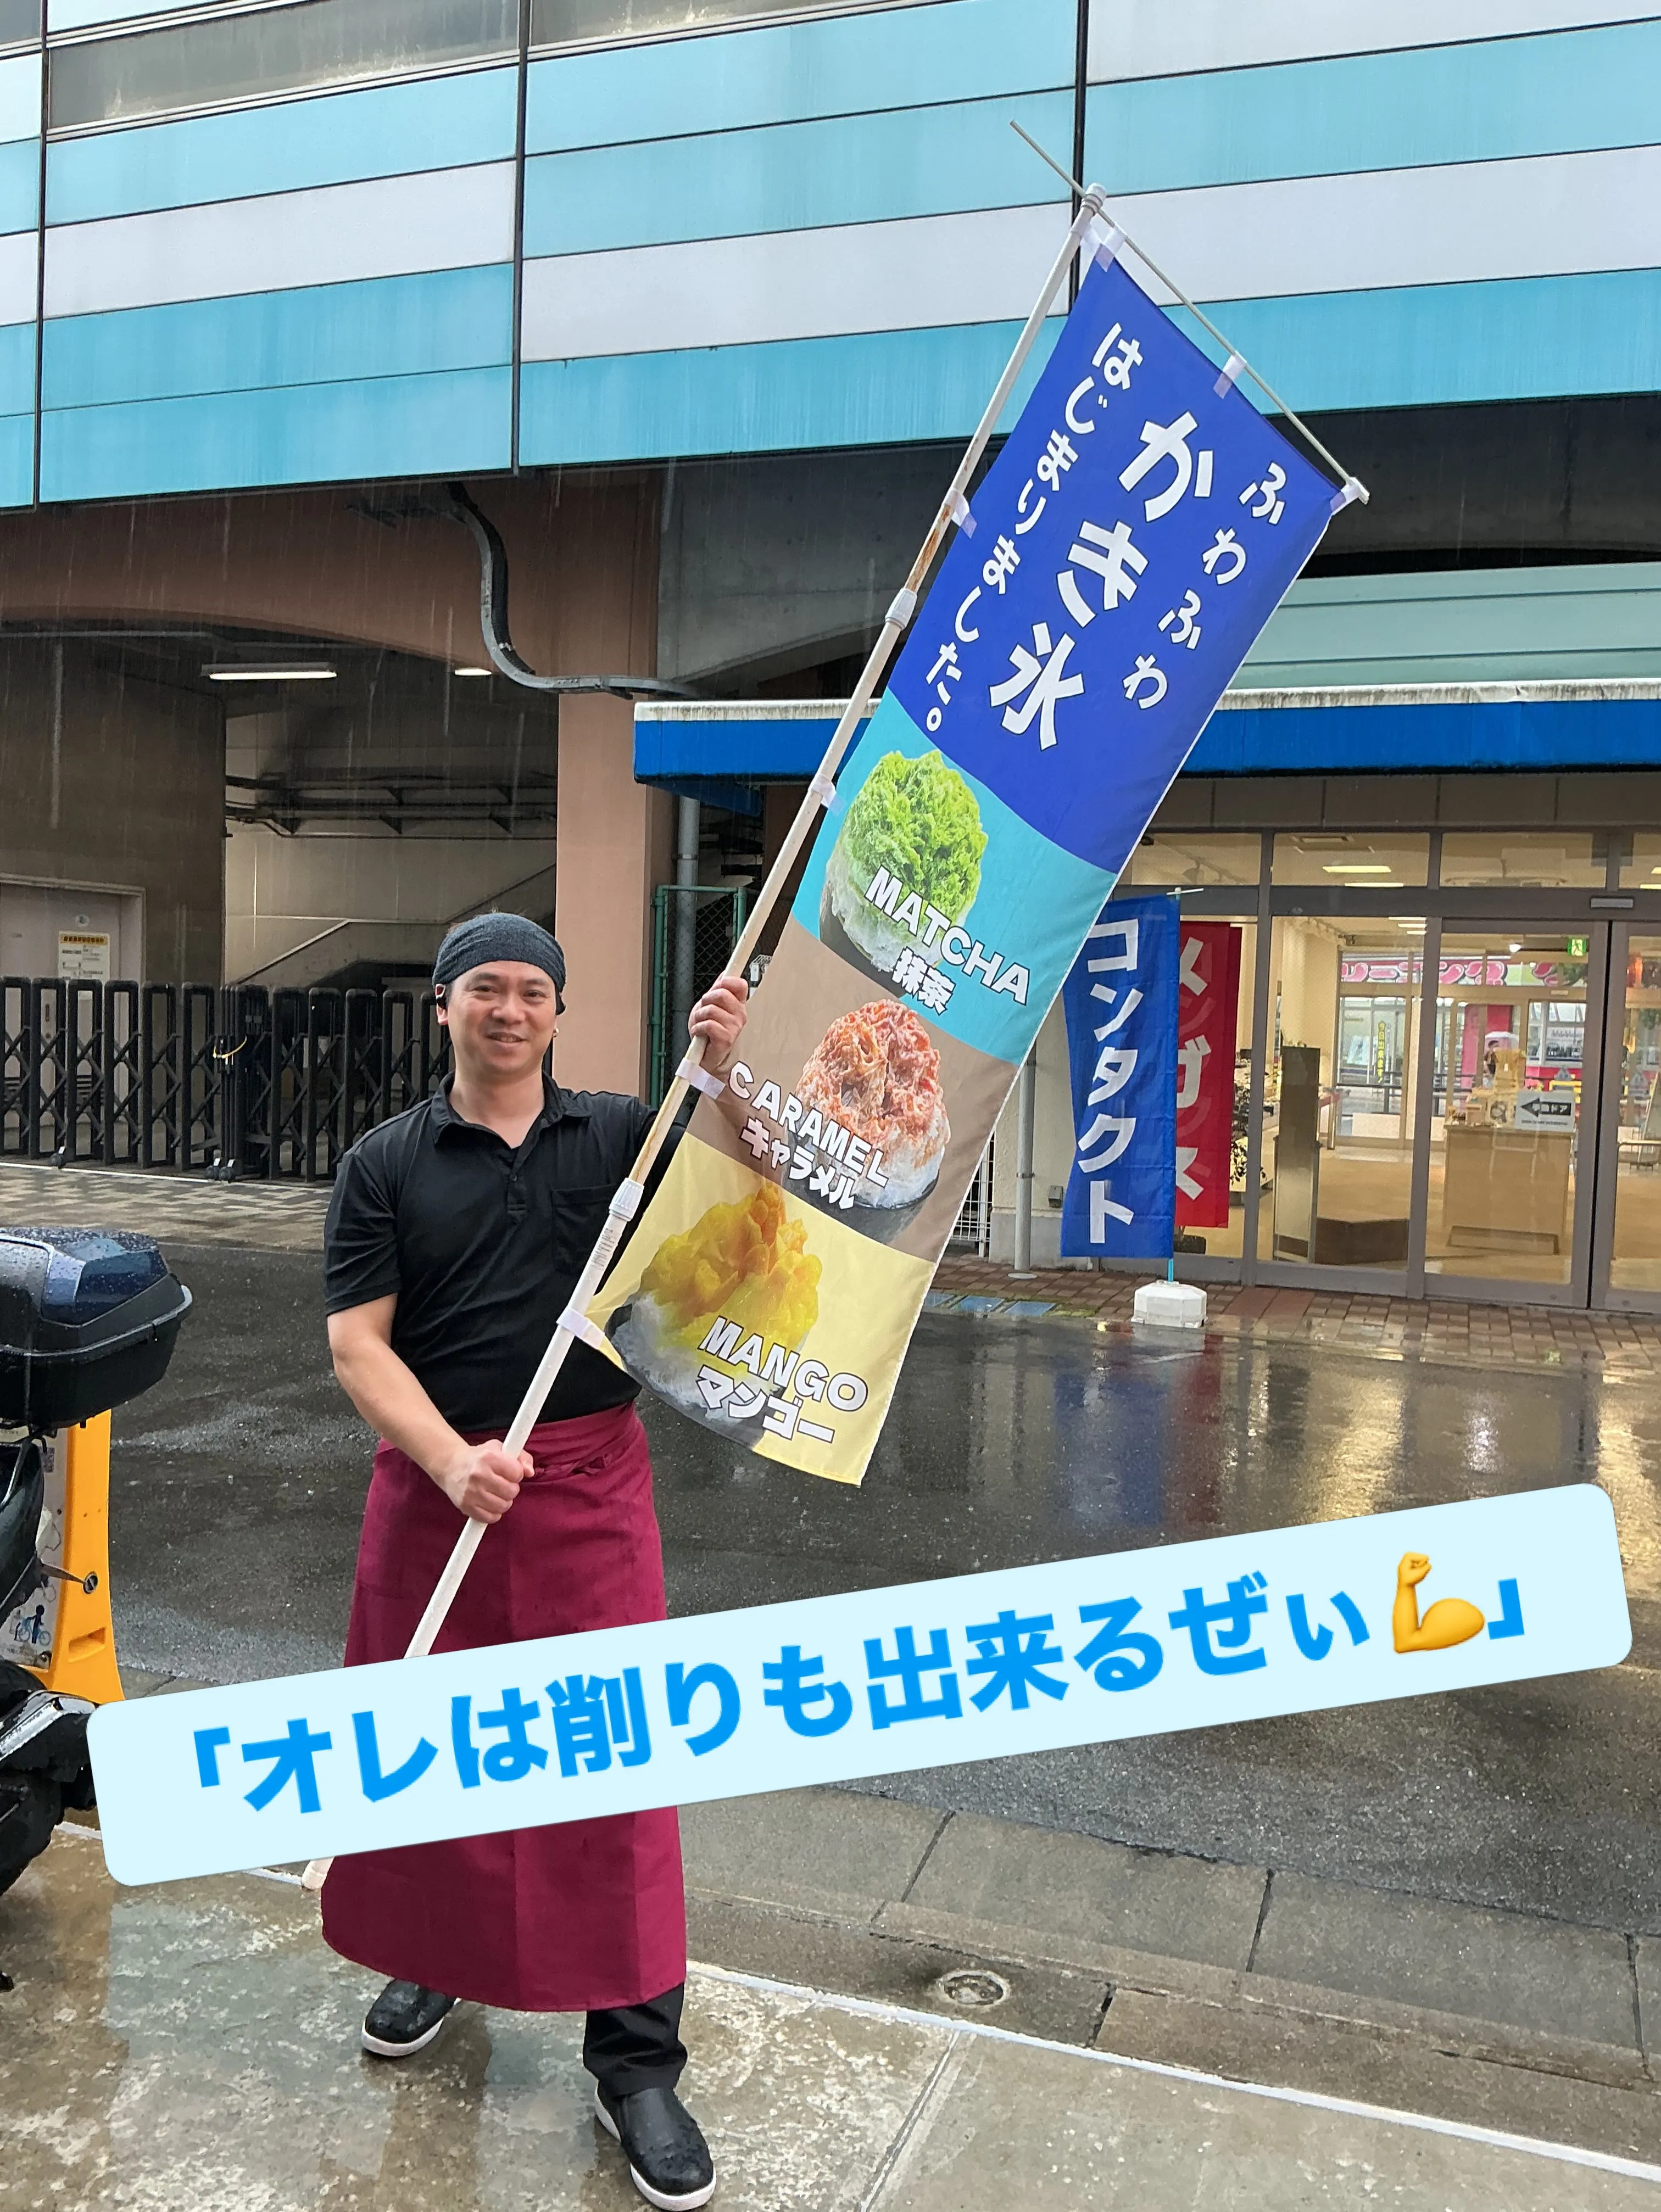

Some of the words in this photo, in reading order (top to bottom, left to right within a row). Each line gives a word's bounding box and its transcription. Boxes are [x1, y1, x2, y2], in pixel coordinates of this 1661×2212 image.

[926, 322, 1143, 731] はじまりました。
[989, 411, 1213, 750] かき氷
[1123, 462, 1286, 709] ふわふわ
[866, 868, 1030, 1006] MATCHA
[892, 947, 956, 1015] 抹茶
[729, 1060, 889, 1189] CARAMEL
[1078, 918, 1143, 1244] コンタクト
[740, 1116, 857, 1210] キャラメル
[696, 1365, 835, 1444] マンゴー
[699, 1316, 868, 1413] MANGO
